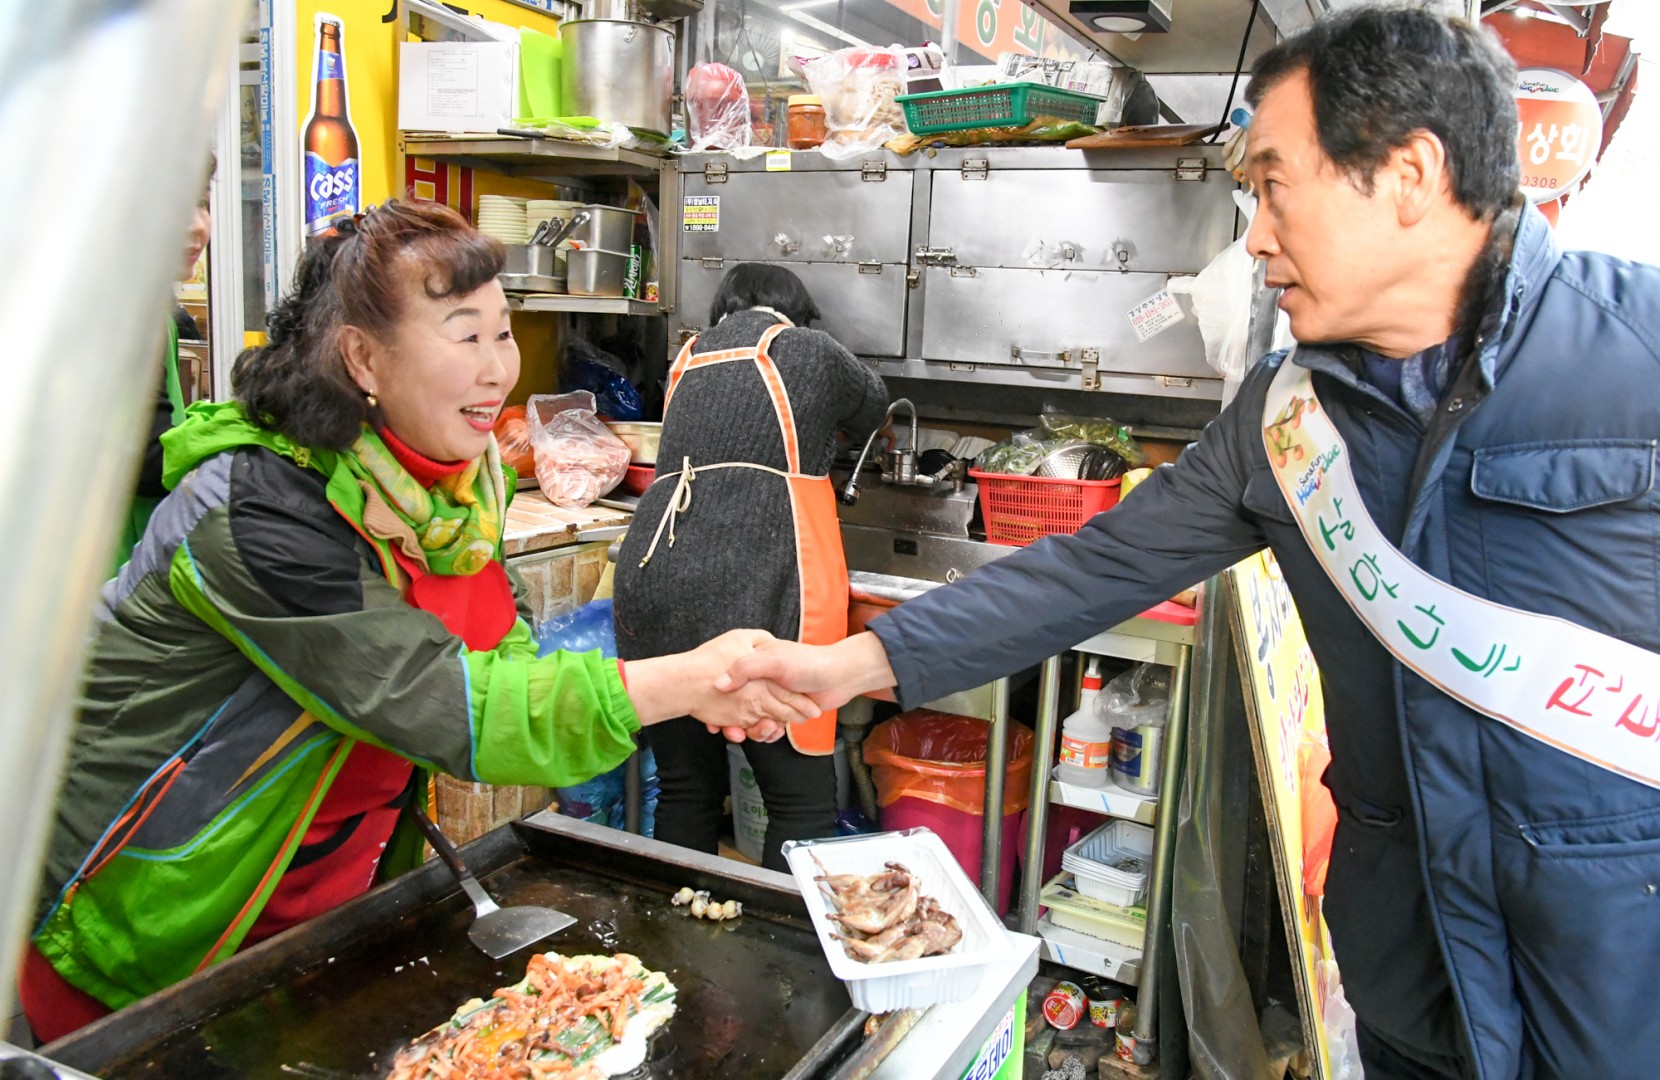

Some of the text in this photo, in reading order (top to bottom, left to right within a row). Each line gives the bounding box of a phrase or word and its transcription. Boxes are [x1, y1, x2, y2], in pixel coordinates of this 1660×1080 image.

[1516, 121, 1590, 167] 상회
[320, 195, 349, 209] FRESH
[1296, 444, 1341, 506] Haeundae
